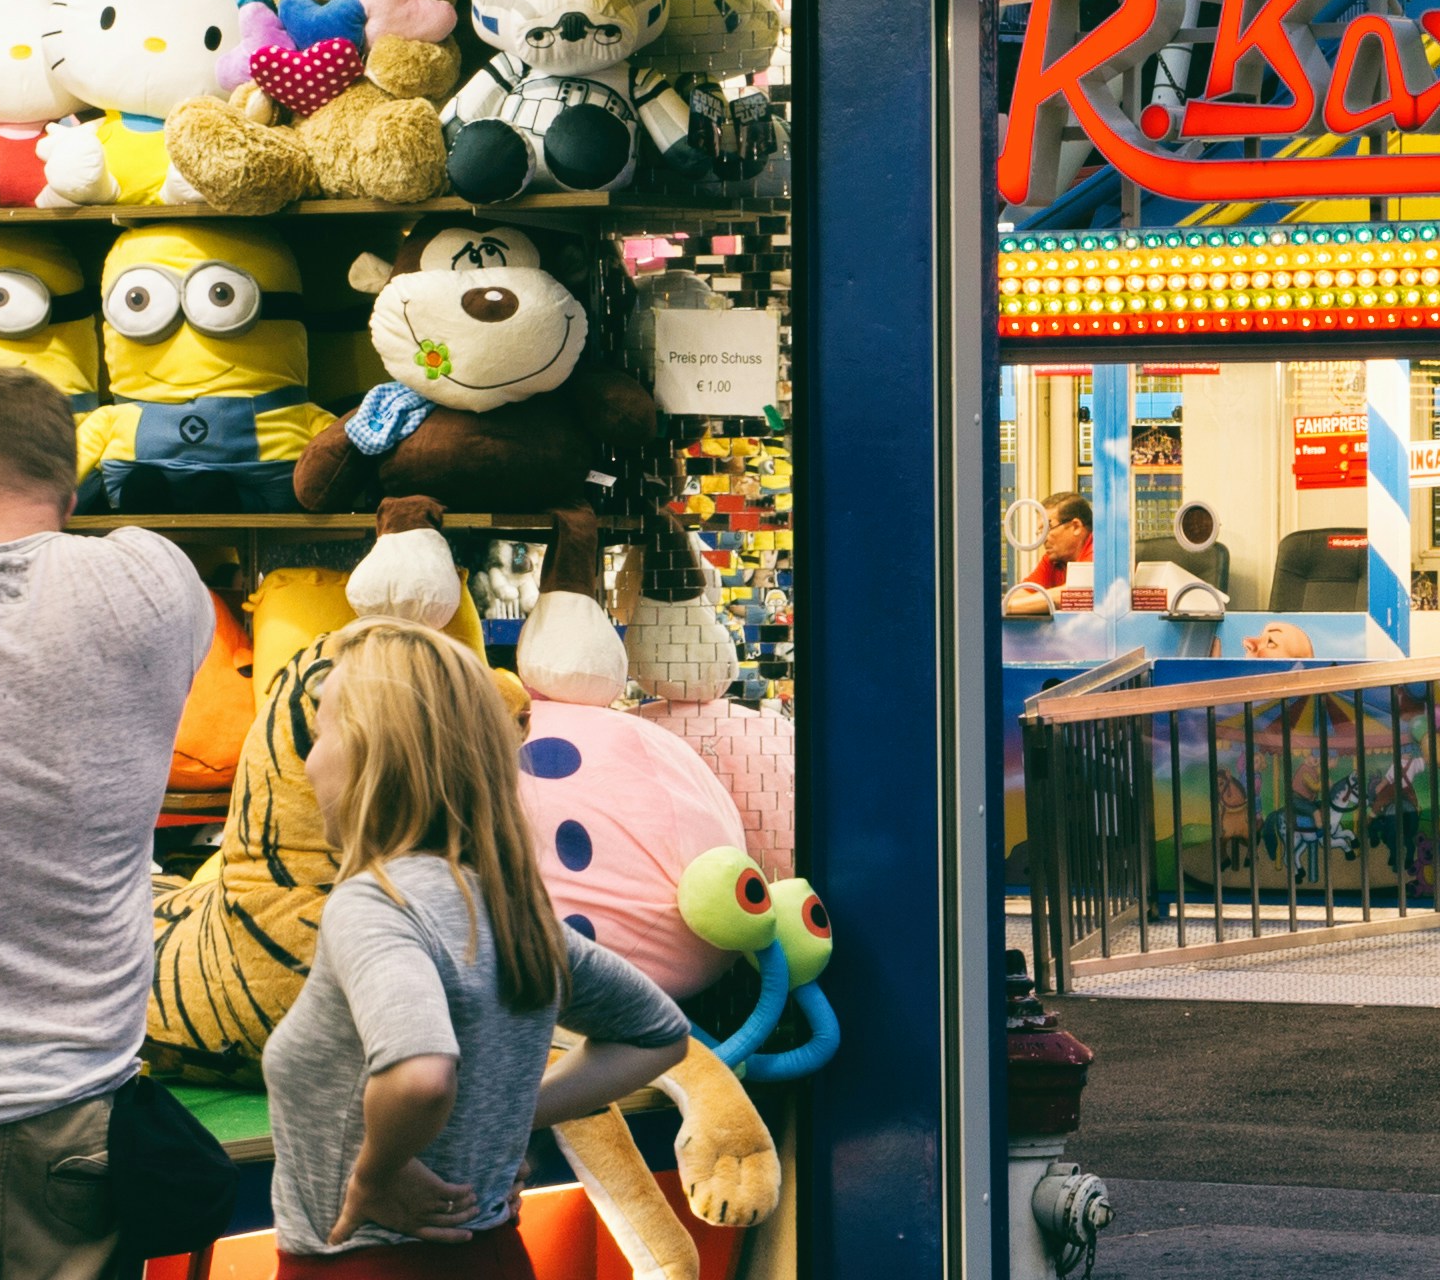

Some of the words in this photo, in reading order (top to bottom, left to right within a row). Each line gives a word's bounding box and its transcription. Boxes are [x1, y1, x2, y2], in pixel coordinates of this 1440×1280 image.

[669, 351, 696, 364] Preis
[699, 354, 718, 366] pro
[721, 351, 762, 365] Schuss
[708, 380, 731, 393] 1,00
[1296, 415, 1368, 434] FAHRPREIS
